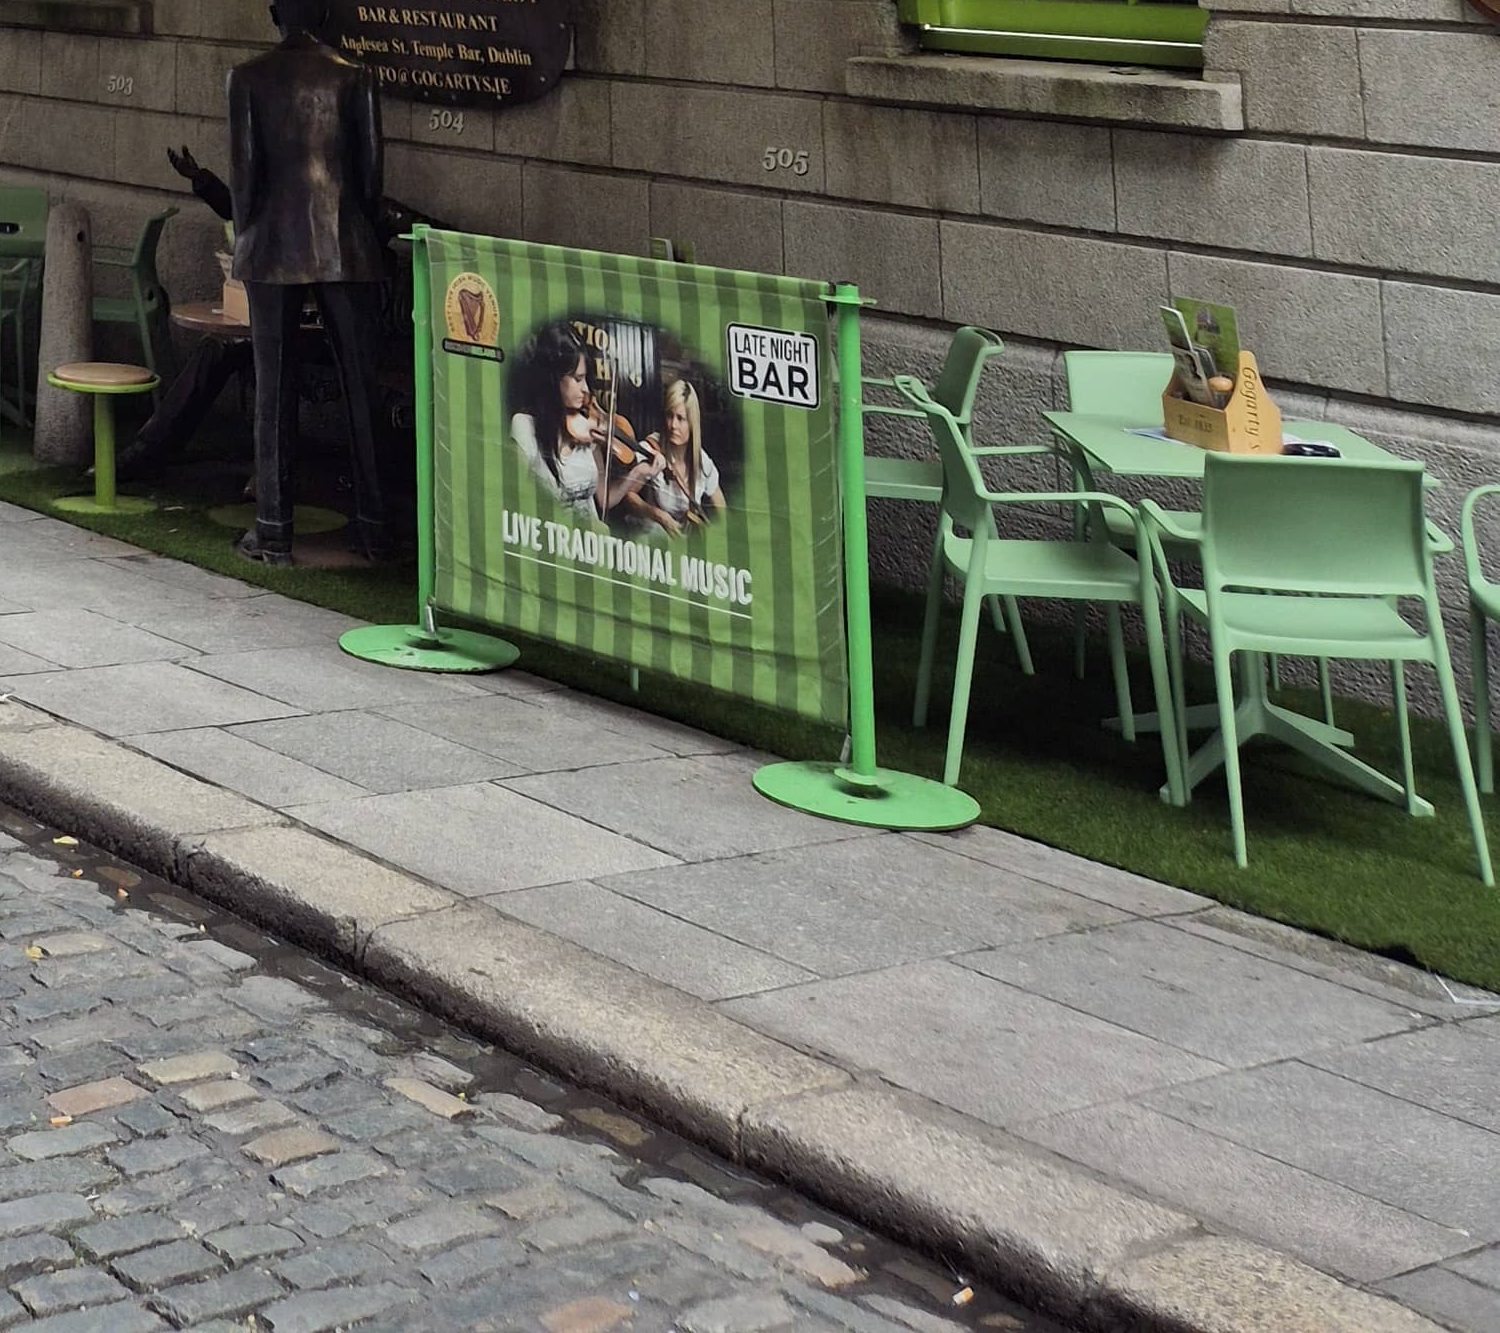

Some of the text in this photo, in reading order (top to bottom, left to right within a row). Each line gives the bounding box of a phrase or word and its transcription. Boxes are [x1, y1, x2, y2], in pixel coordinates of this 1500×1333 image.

[357, 6, 498, 32] BAR & RESTAURANT
[340, 34, 389, 56] Anglesea
[412, 40, 455, 61] Temple
[458, 44, 485, 65] Bar,
[487, 47, 532, 66] Dublin
[107, 75, 134, 96] 503
[411, 69, 512, 95] GOGARTYS.IE
[428, 108, 466, 134] 504
[762, 146, 810, 176] 505
[734, 332, 810, 365] LATE NIGHT
[738, 356, 809, 401] BAR
[501, 509, 753, 606] LIVE TRADITIONAL MUSIC
